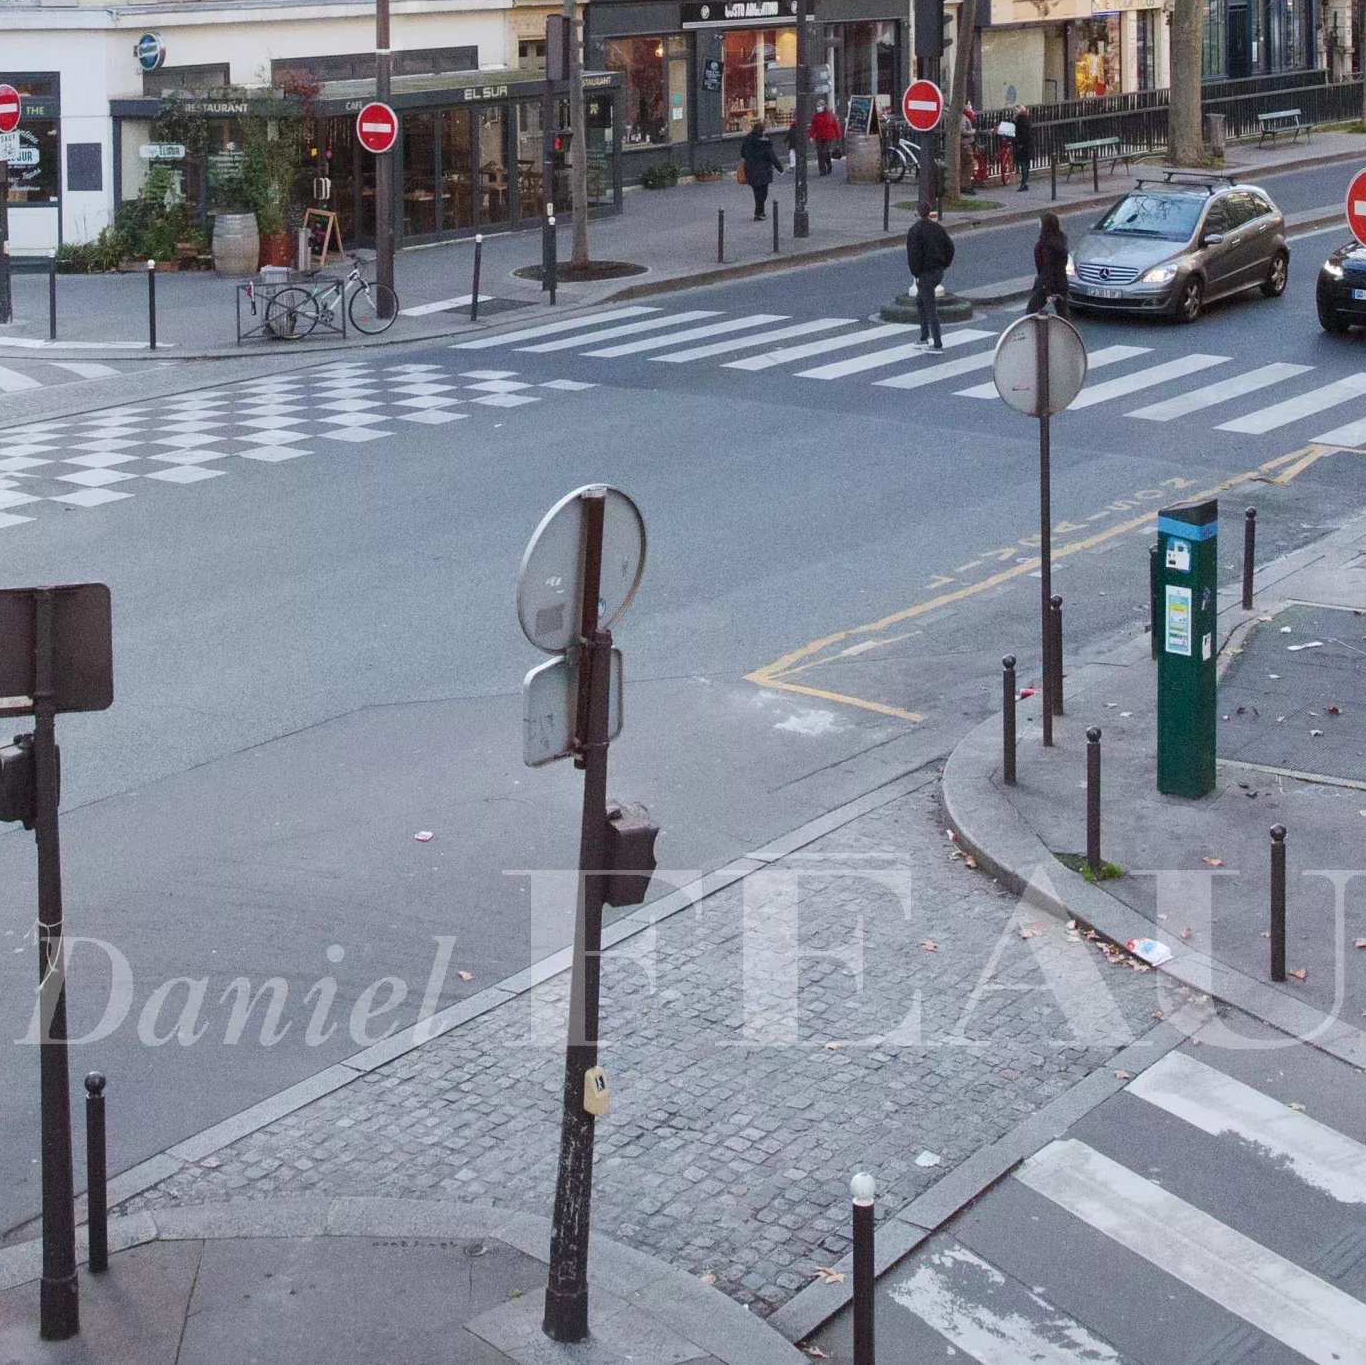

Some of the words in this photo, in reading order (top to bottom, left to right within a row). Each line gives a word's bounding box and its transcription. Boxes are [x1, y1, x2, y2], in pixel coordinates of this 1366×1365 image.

[581, 77, 611, 87] STAURANT
[464, 90, 481, 100] EL
[483, 86, 508, 98] SUR
[26, 106, 44, 115] THE
[185, 103, 248, 112] RESTAURANT
